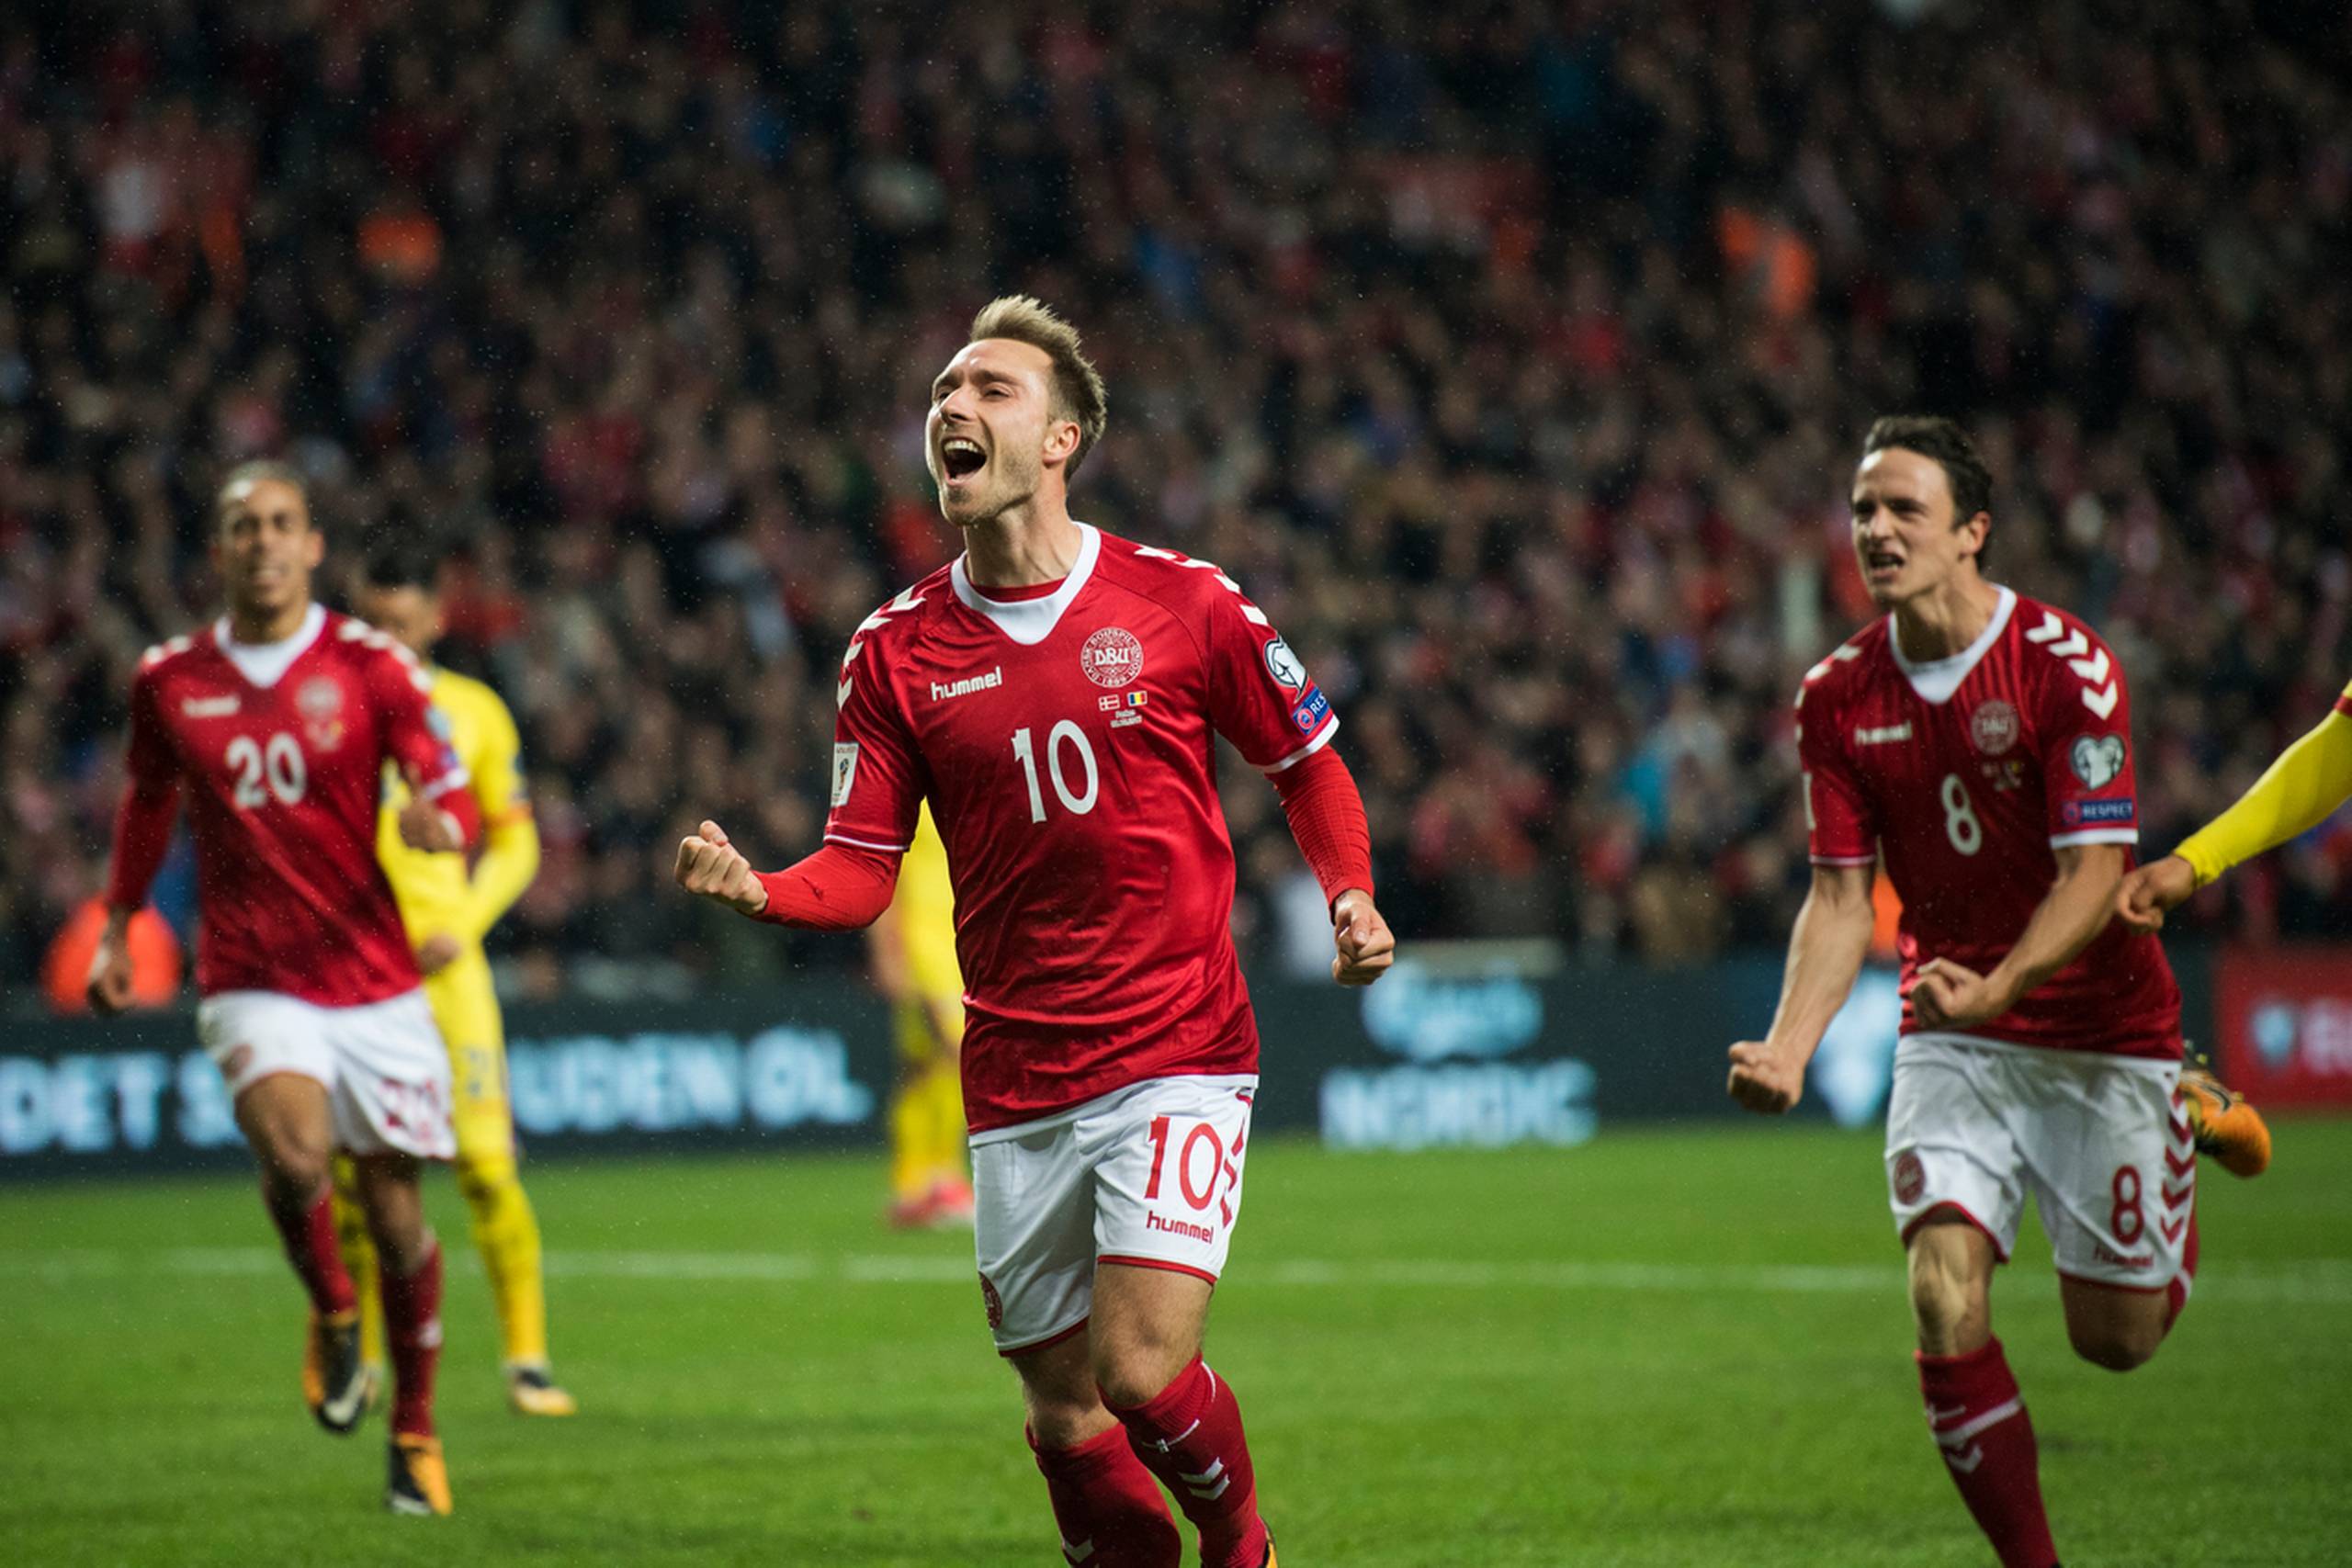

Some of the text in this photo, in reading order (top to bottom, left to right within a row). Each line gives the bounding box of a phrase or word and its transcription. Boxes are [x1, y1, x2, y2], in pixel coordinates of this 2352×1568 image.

[931, 666, 1002, 702] hummel
[1094, 647, 1130, 665] DBU
[226, 733, 306, 807] 20
[1011, 719, 1098, 824] 10
[1940, 773, 1982, 855] 8
[2083, 803, 2132, 818] RESPECT
[1144, 1113, 1223, 1211] 10
[1146, 1211, 1214, 1245] hummel
[2110, 1165, 2144, 1245] 8
